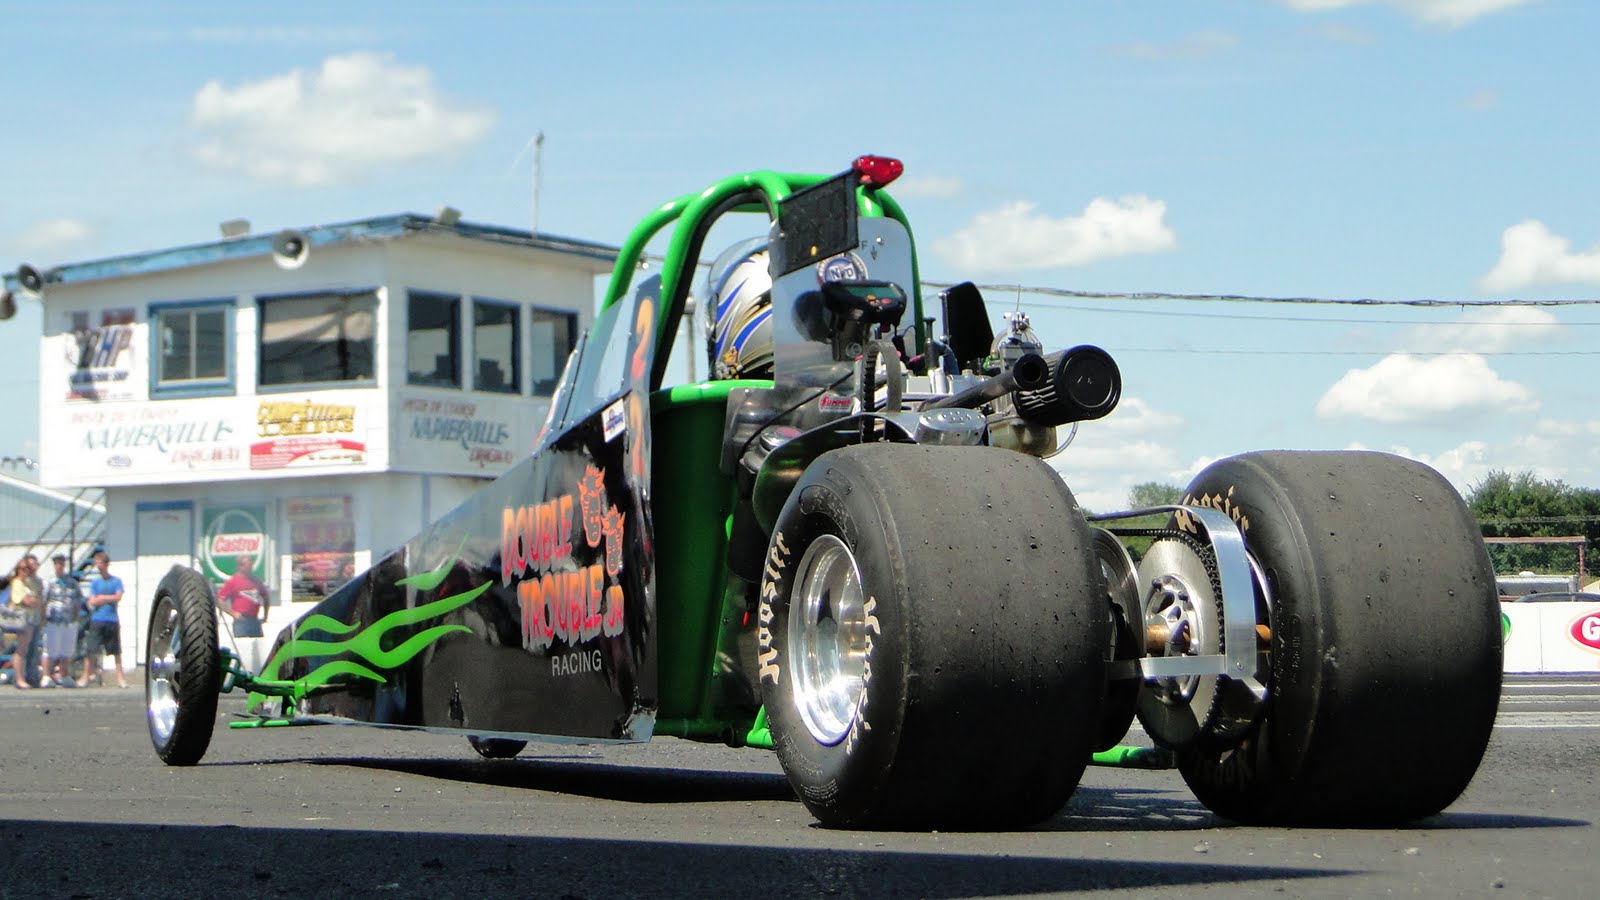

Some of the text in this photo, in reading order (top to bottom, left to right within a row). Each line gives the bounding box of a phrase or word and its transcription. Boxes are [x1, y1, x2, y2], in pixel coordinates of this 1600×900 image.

[82, 419, 233, 453] NAPIERVILLE
[410, 416, 509, 450] NAPIERVILLE
[215, 535, 260, 553] Castrol
[502, 495, 573, 586] DOUBLE
[517, 564, 604, 649] TROUBLE
[552, 649, 602, 677] RACING
